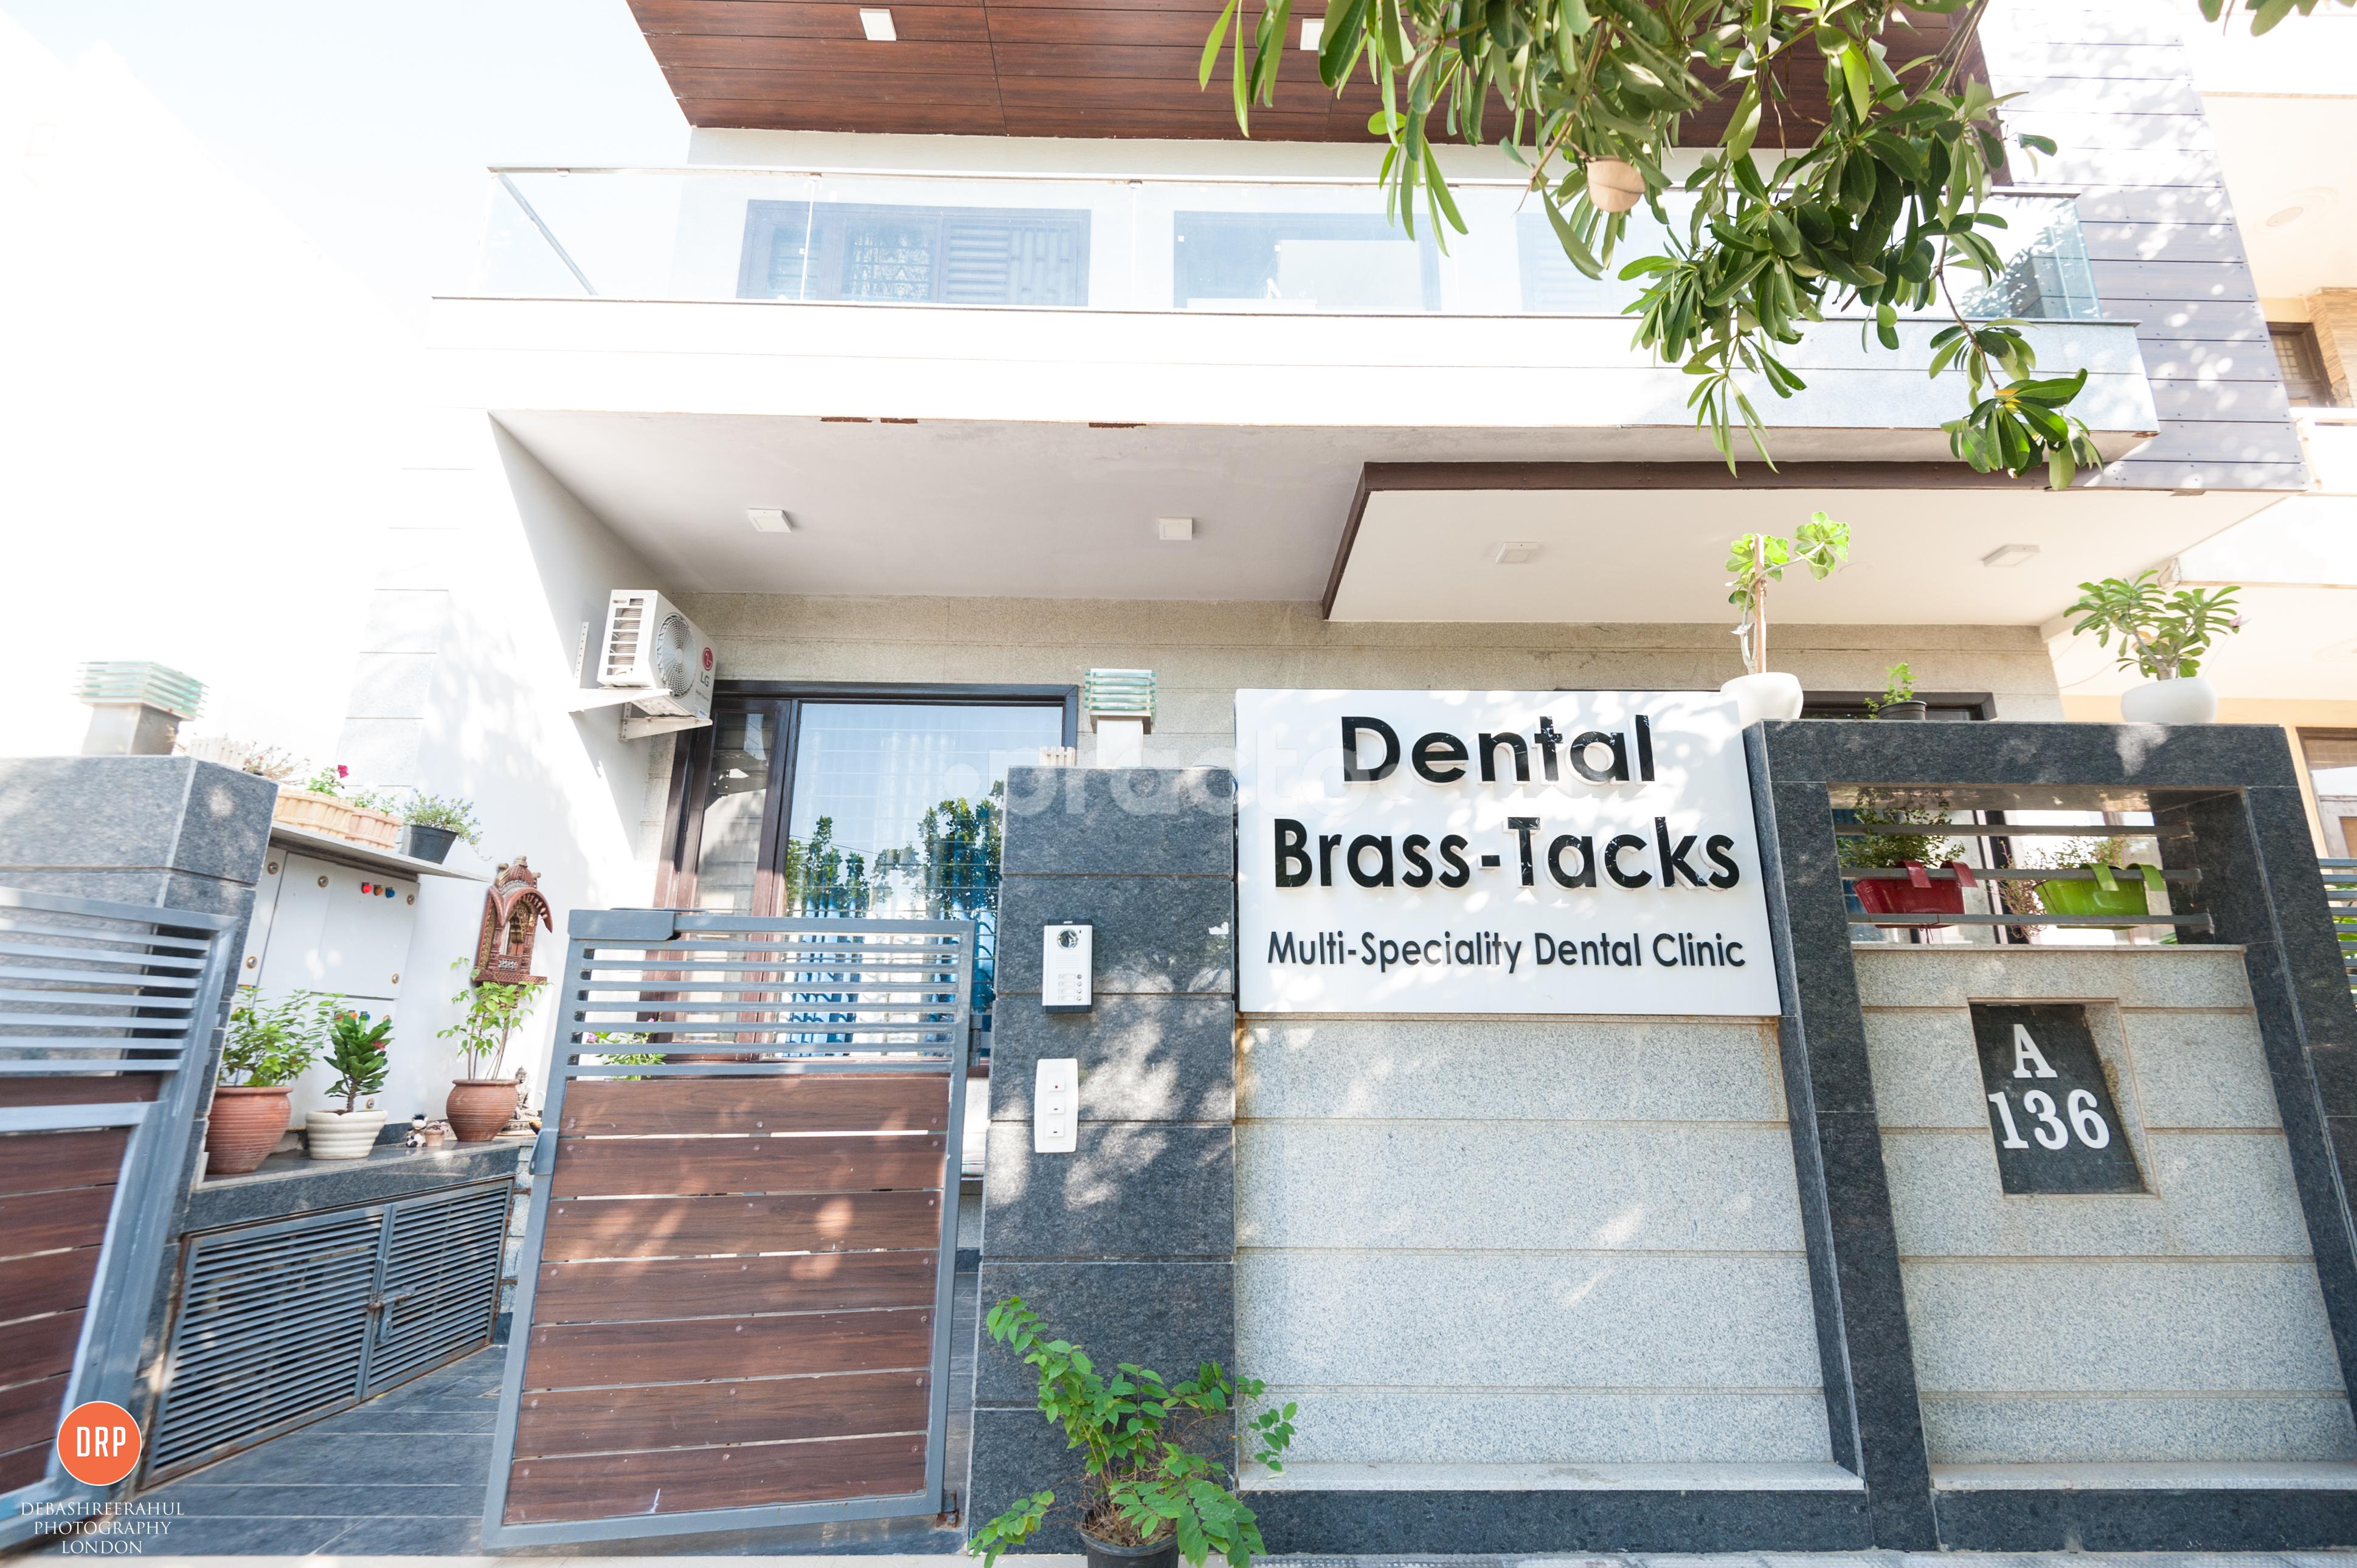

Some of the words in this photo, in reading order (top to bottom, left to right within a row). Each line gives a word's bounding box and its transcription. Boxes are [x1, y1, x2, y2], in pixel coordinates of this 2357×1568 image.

[700, 671, 710, 687] LG
[1341, 714, 1655, 784] Dental
[1273, 816, 1740, 889] Brass-Tacks
[1267, 931, 1522, 974] Multi-Speciality
[1534, 933, 1642, 967] Dental
[1652, 932, 1746, 968] Clinic
[2013, 1024, 2058, 1078] A
[1988, 1089, 2110, 1150] 136
